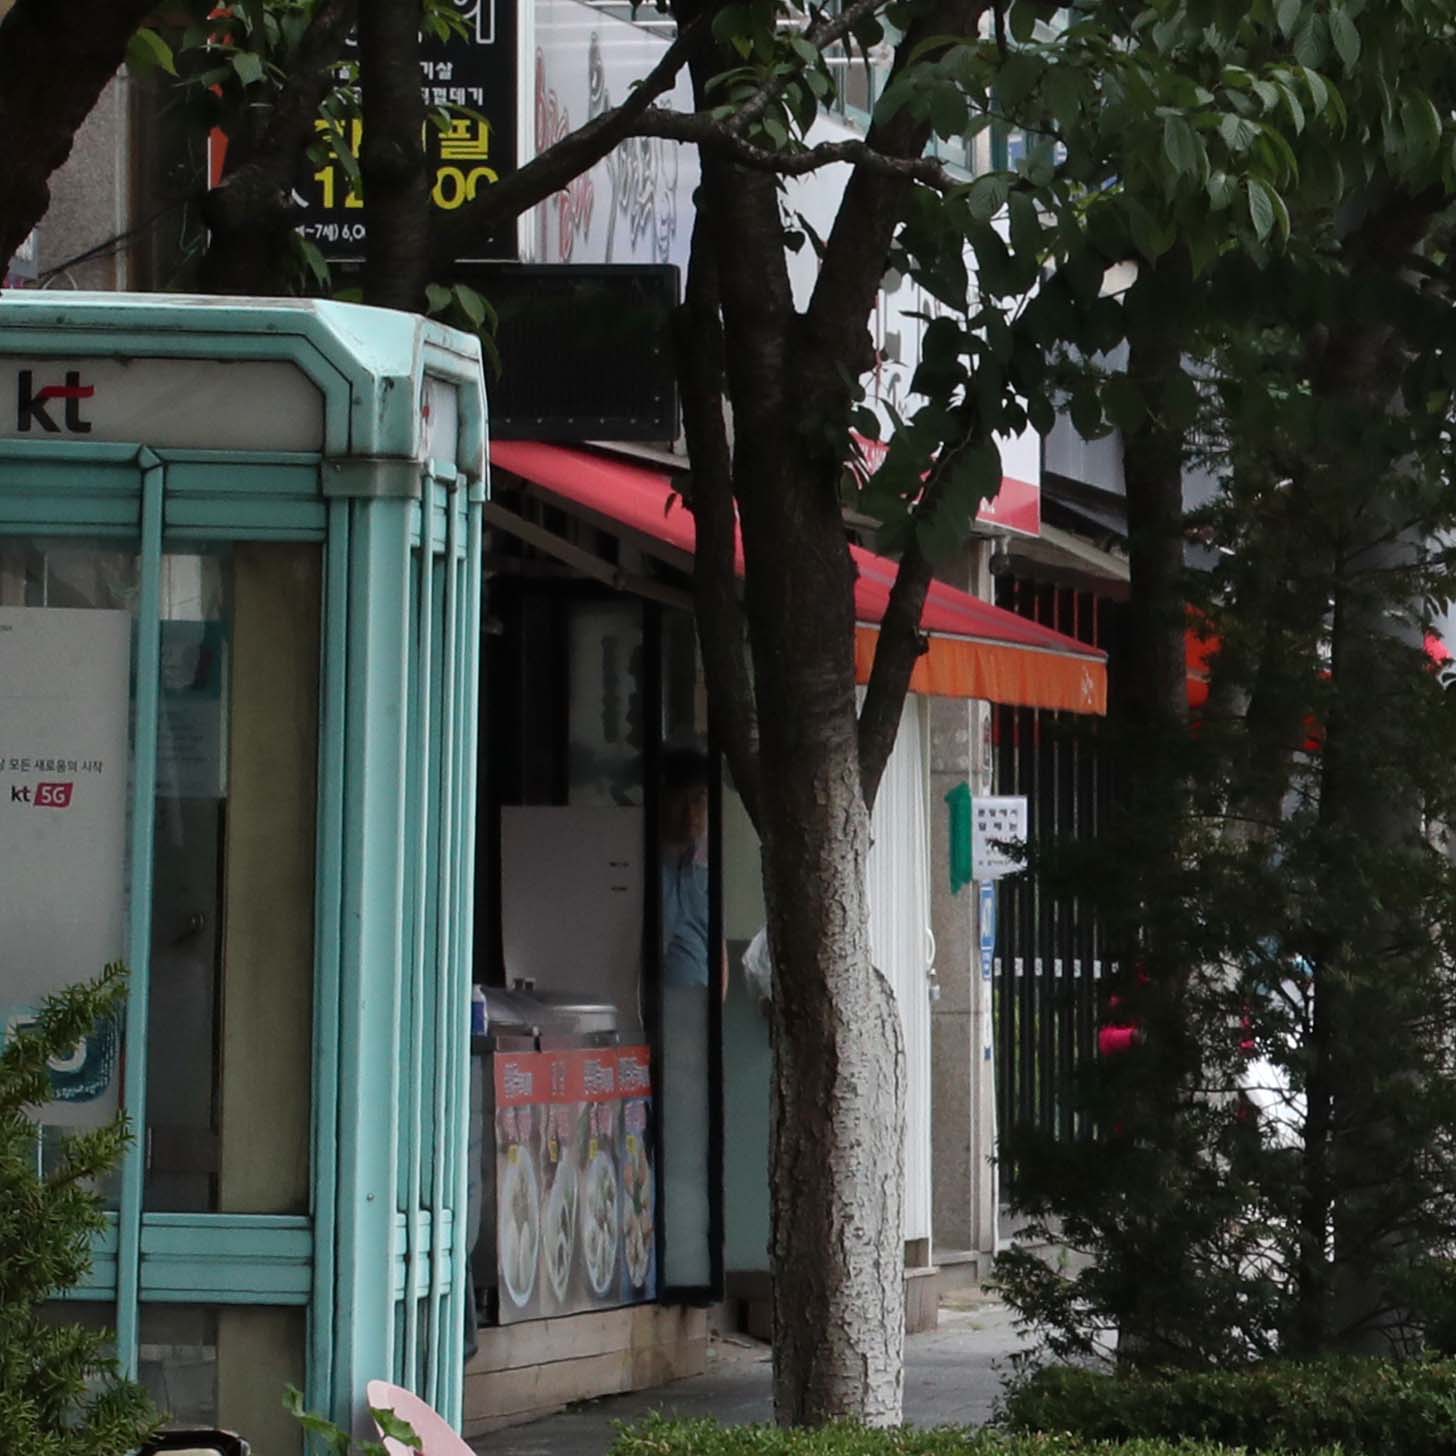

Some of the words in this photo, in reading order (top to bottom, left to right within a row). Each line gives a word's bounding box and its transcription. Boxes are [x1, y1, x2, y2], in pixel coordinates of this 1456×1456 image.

[17, 369, 95, 433] kt
[10, 758, 31, 773] 모든
[35, 759, 77, 774] 새로움의
[82, 760, 103, 774] 시작
[11, 786, 31, 802] kt
[41, 786, 66, 804] 5G
